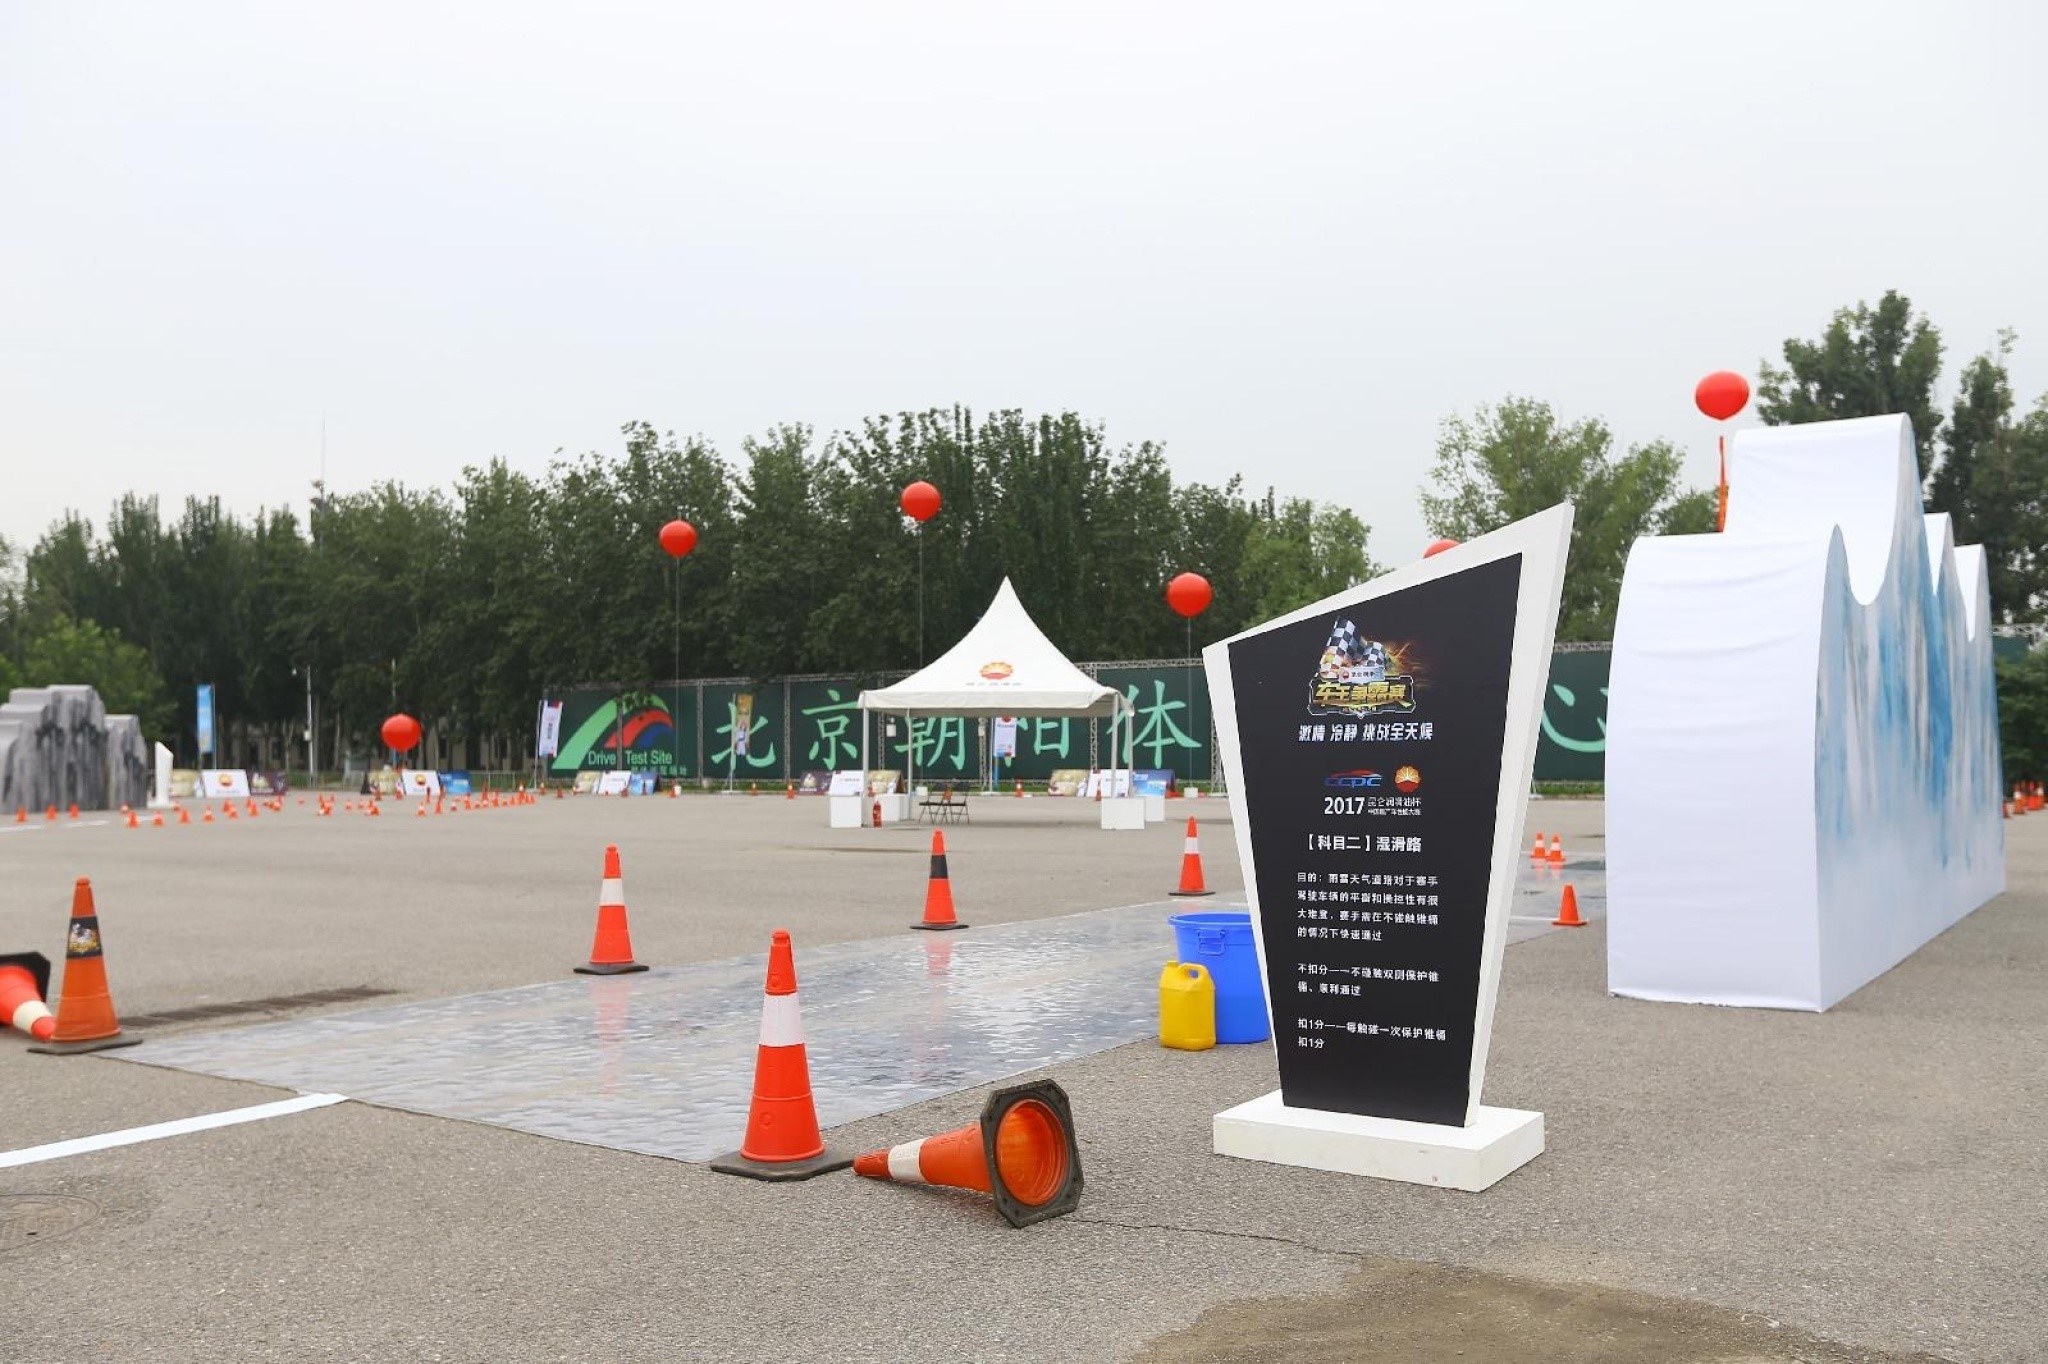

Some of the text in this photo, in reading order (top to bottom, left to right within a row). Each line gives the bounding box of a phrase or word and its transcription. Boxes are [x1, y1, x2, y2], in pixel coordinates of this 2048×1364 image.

[1299, 722, 1433, 742] 激情 冷静 挑战全天候
[588, 749, 673, 765] Drive Test Site
[1324, 796, 1365, 815] 2017
[1308, 833, 1422, 853] 【科目二】湿滑路
[1297, 926, 1383, 941] 的情况下快速通过
[1297, 1036, 1325, 1049] 扣1分
